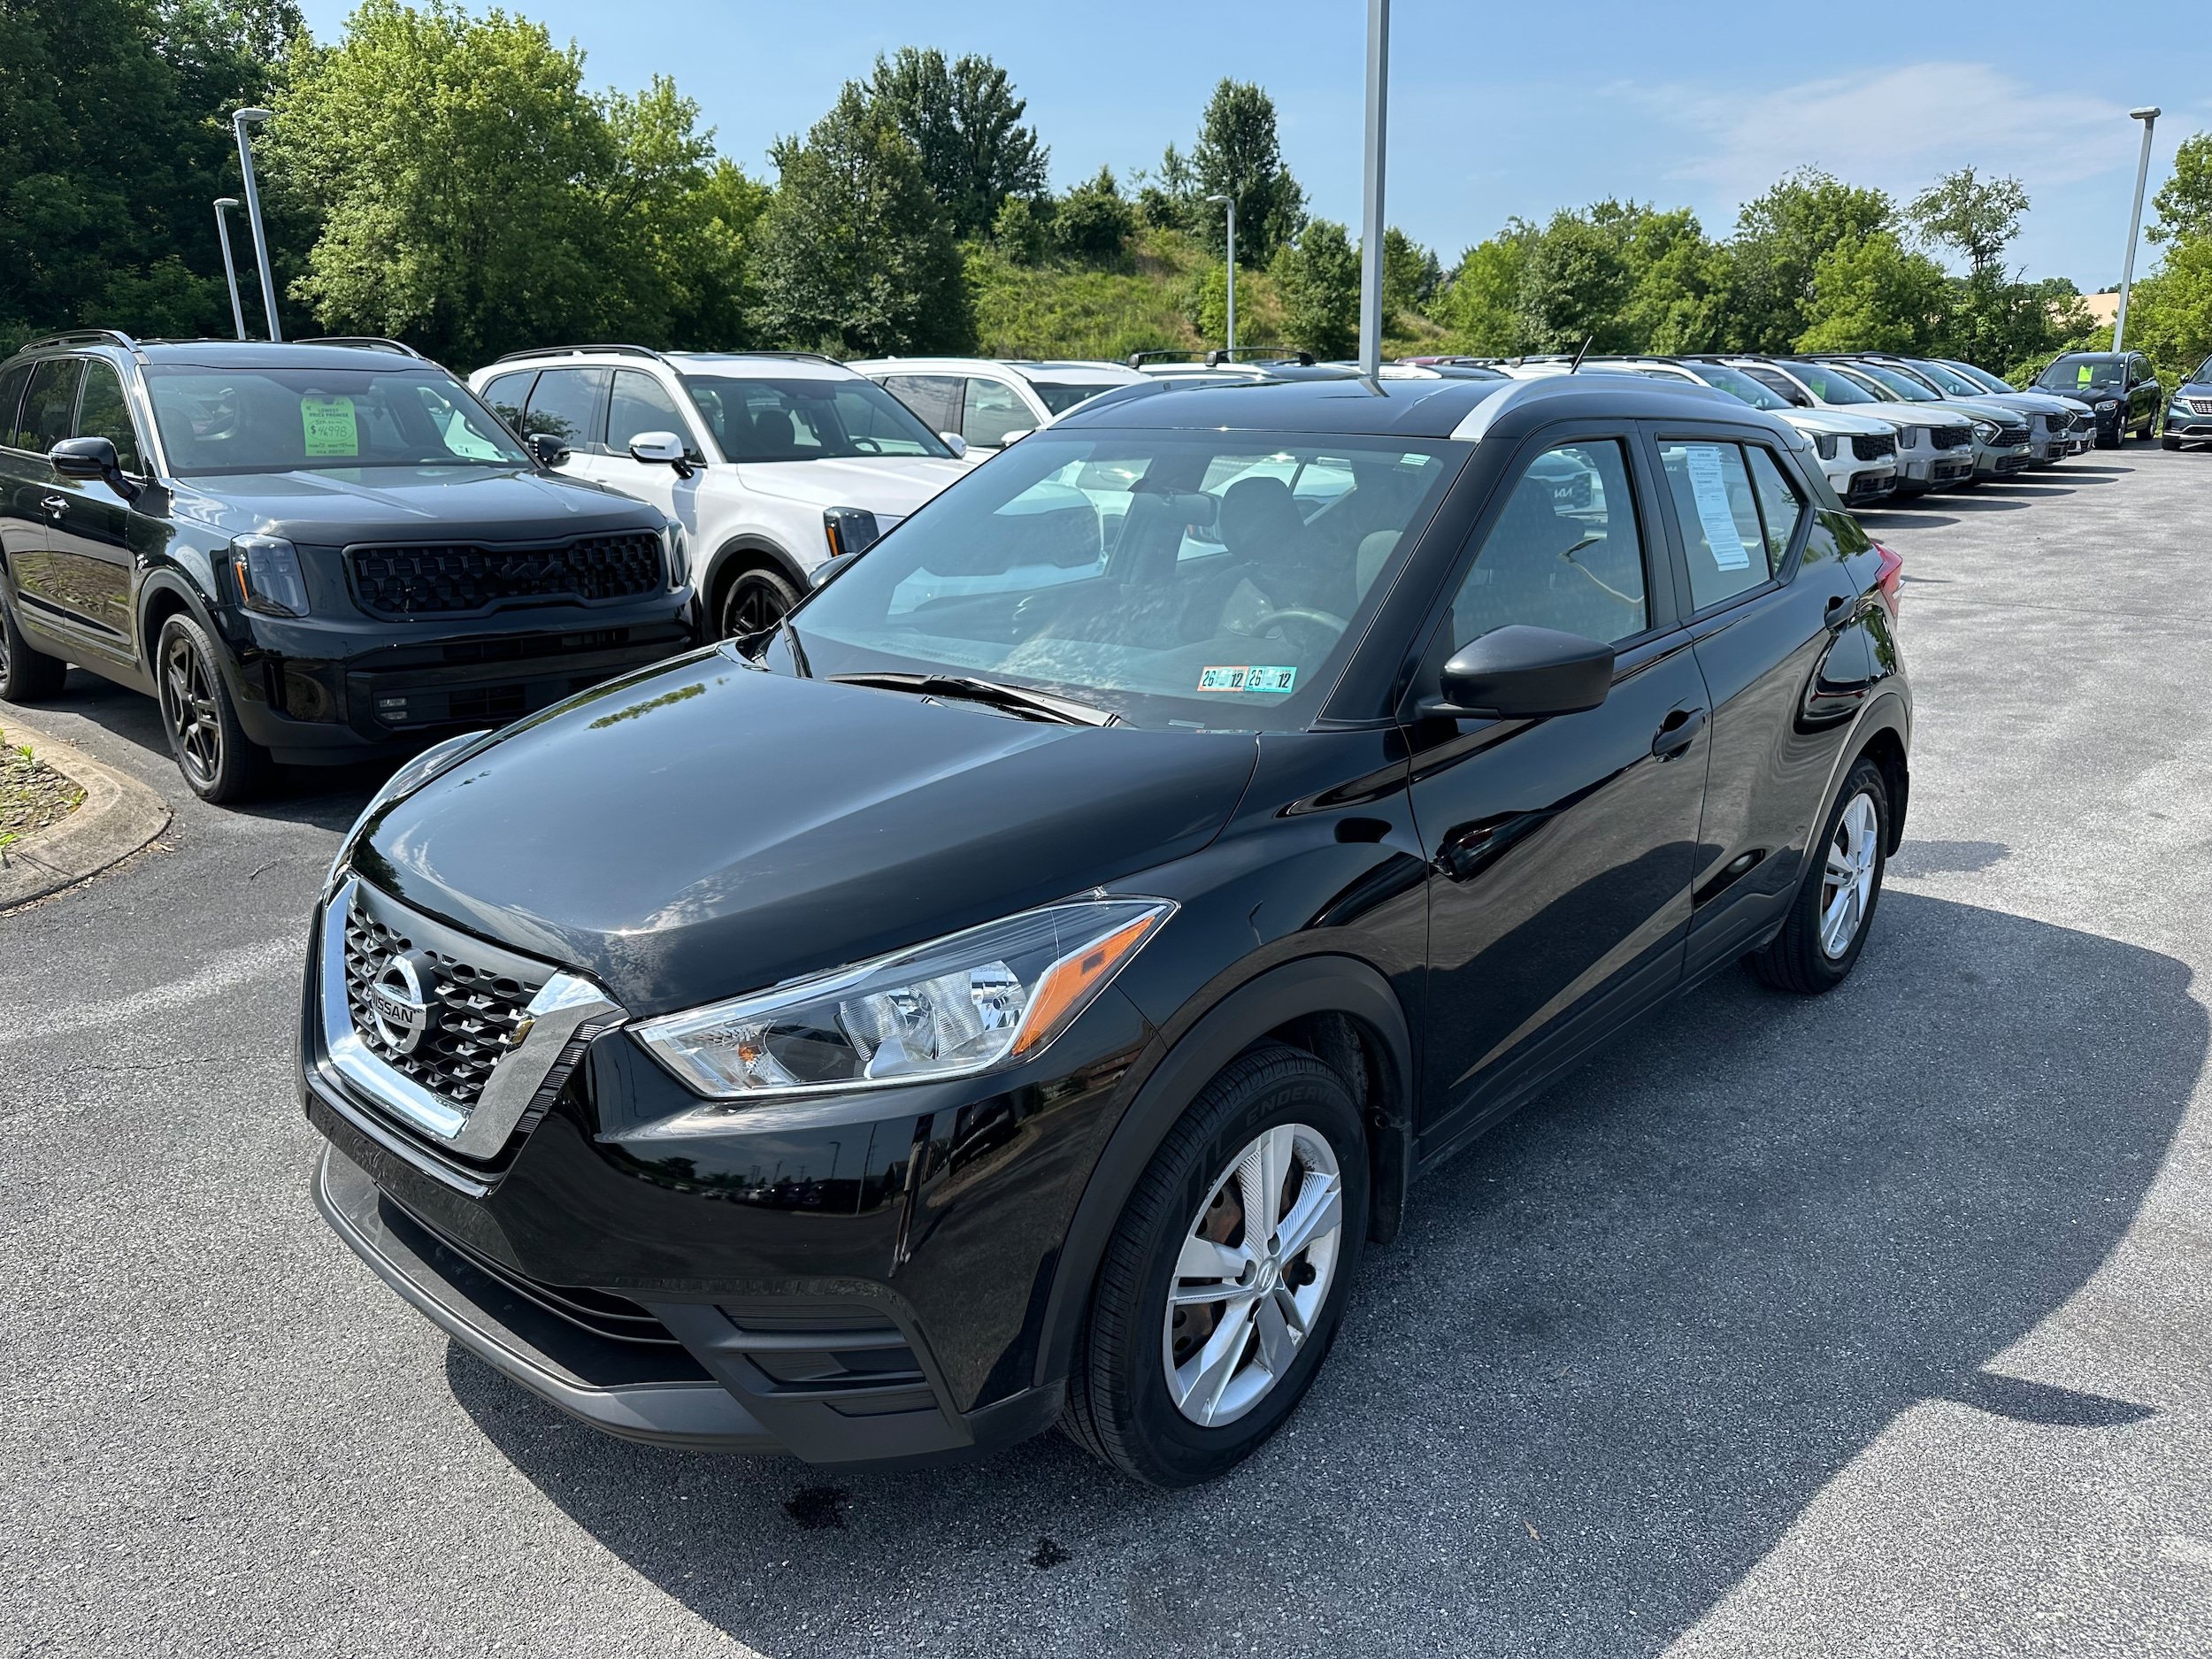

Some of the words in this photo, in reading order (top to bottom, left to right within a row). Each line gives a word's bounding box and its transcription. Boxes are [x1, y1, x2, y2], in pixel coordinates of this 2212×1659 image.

[1202, 670, 1217, 687] 26
[1231, 672, 1244, 687] 12
[1248, 669, 1263, 687] 26
[1278, 672, 1292, 688] 12
[372, 992, 413, 1024] NISSAN
